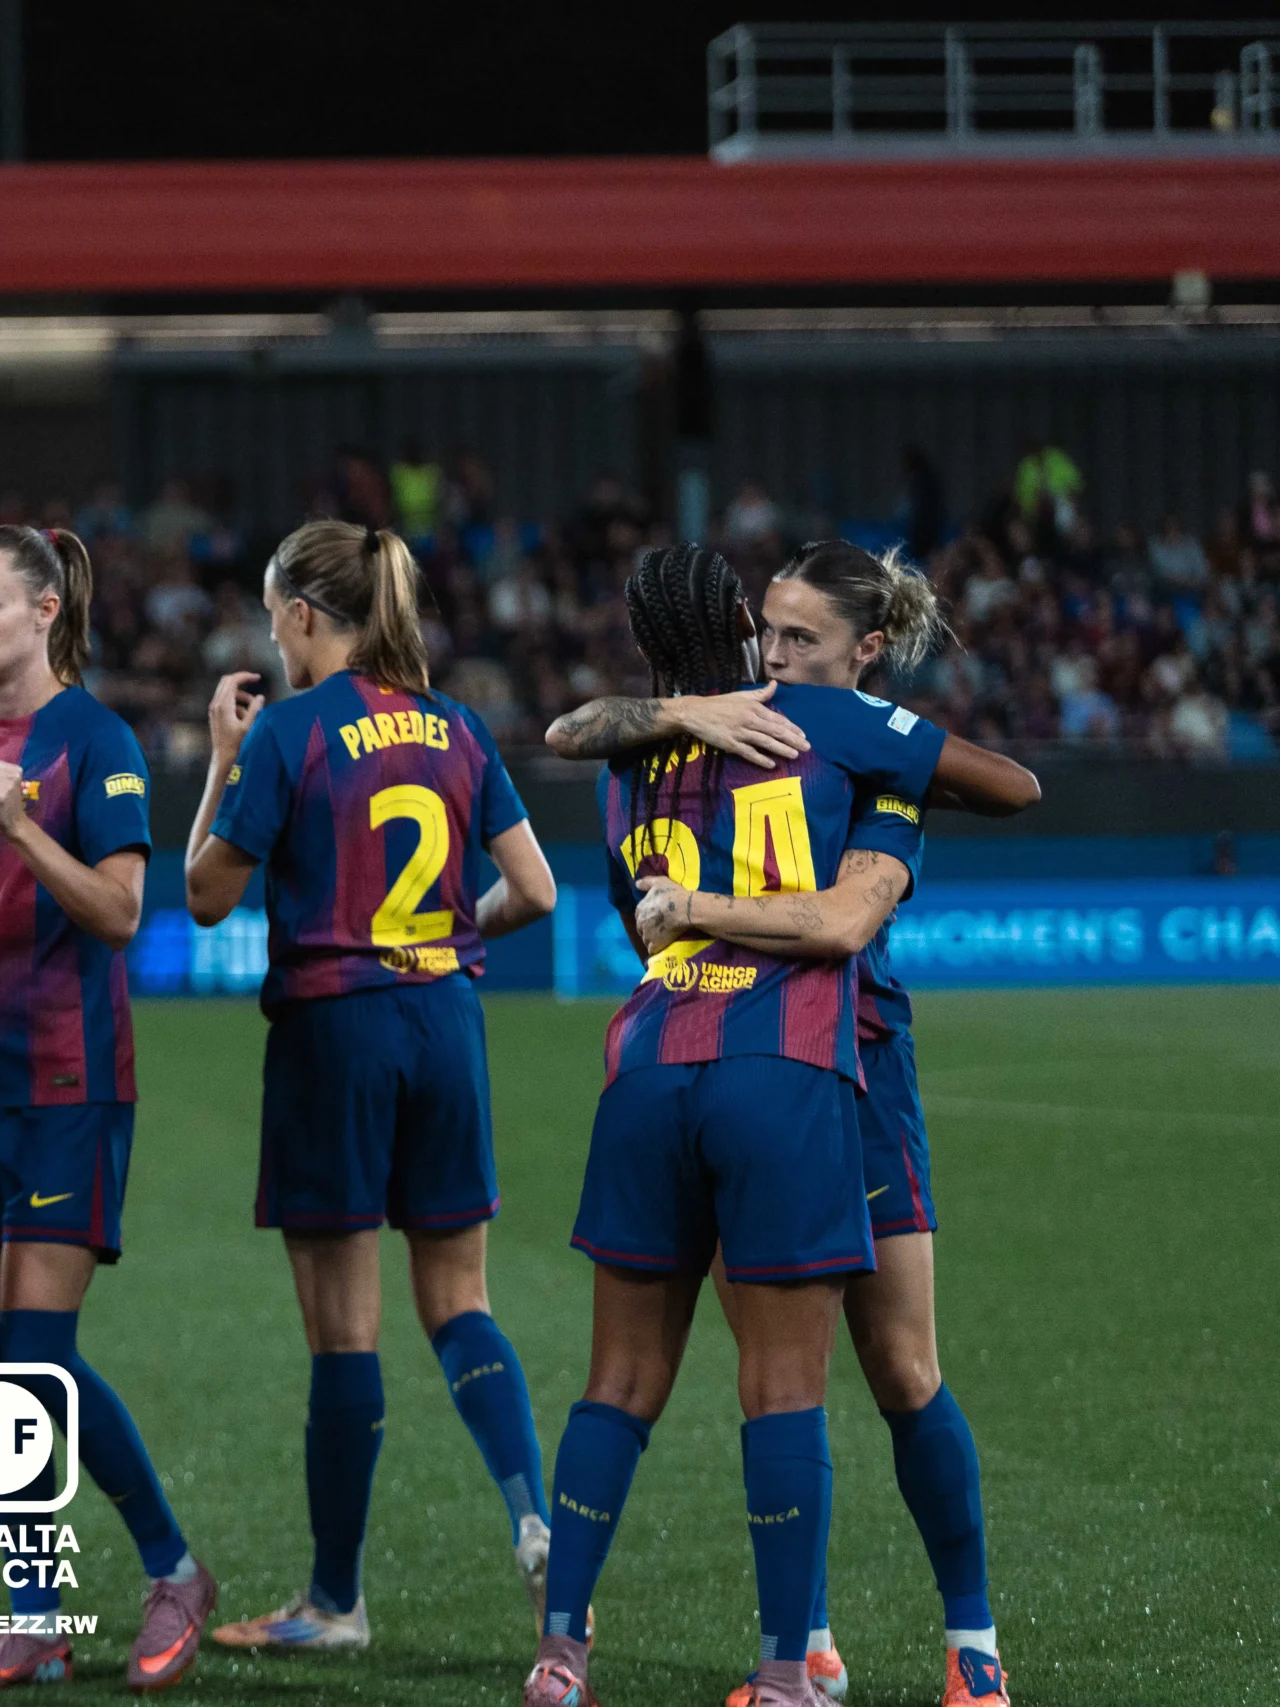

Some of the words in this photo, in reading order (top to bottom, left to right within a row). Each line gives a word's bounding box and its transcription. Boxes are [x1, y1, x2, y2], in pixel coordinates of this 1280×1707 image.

[339, 710, 450, 760] PAREDES
[370, 784, 454, 947] 2
[701, 962, 757, 979] UNHCR
